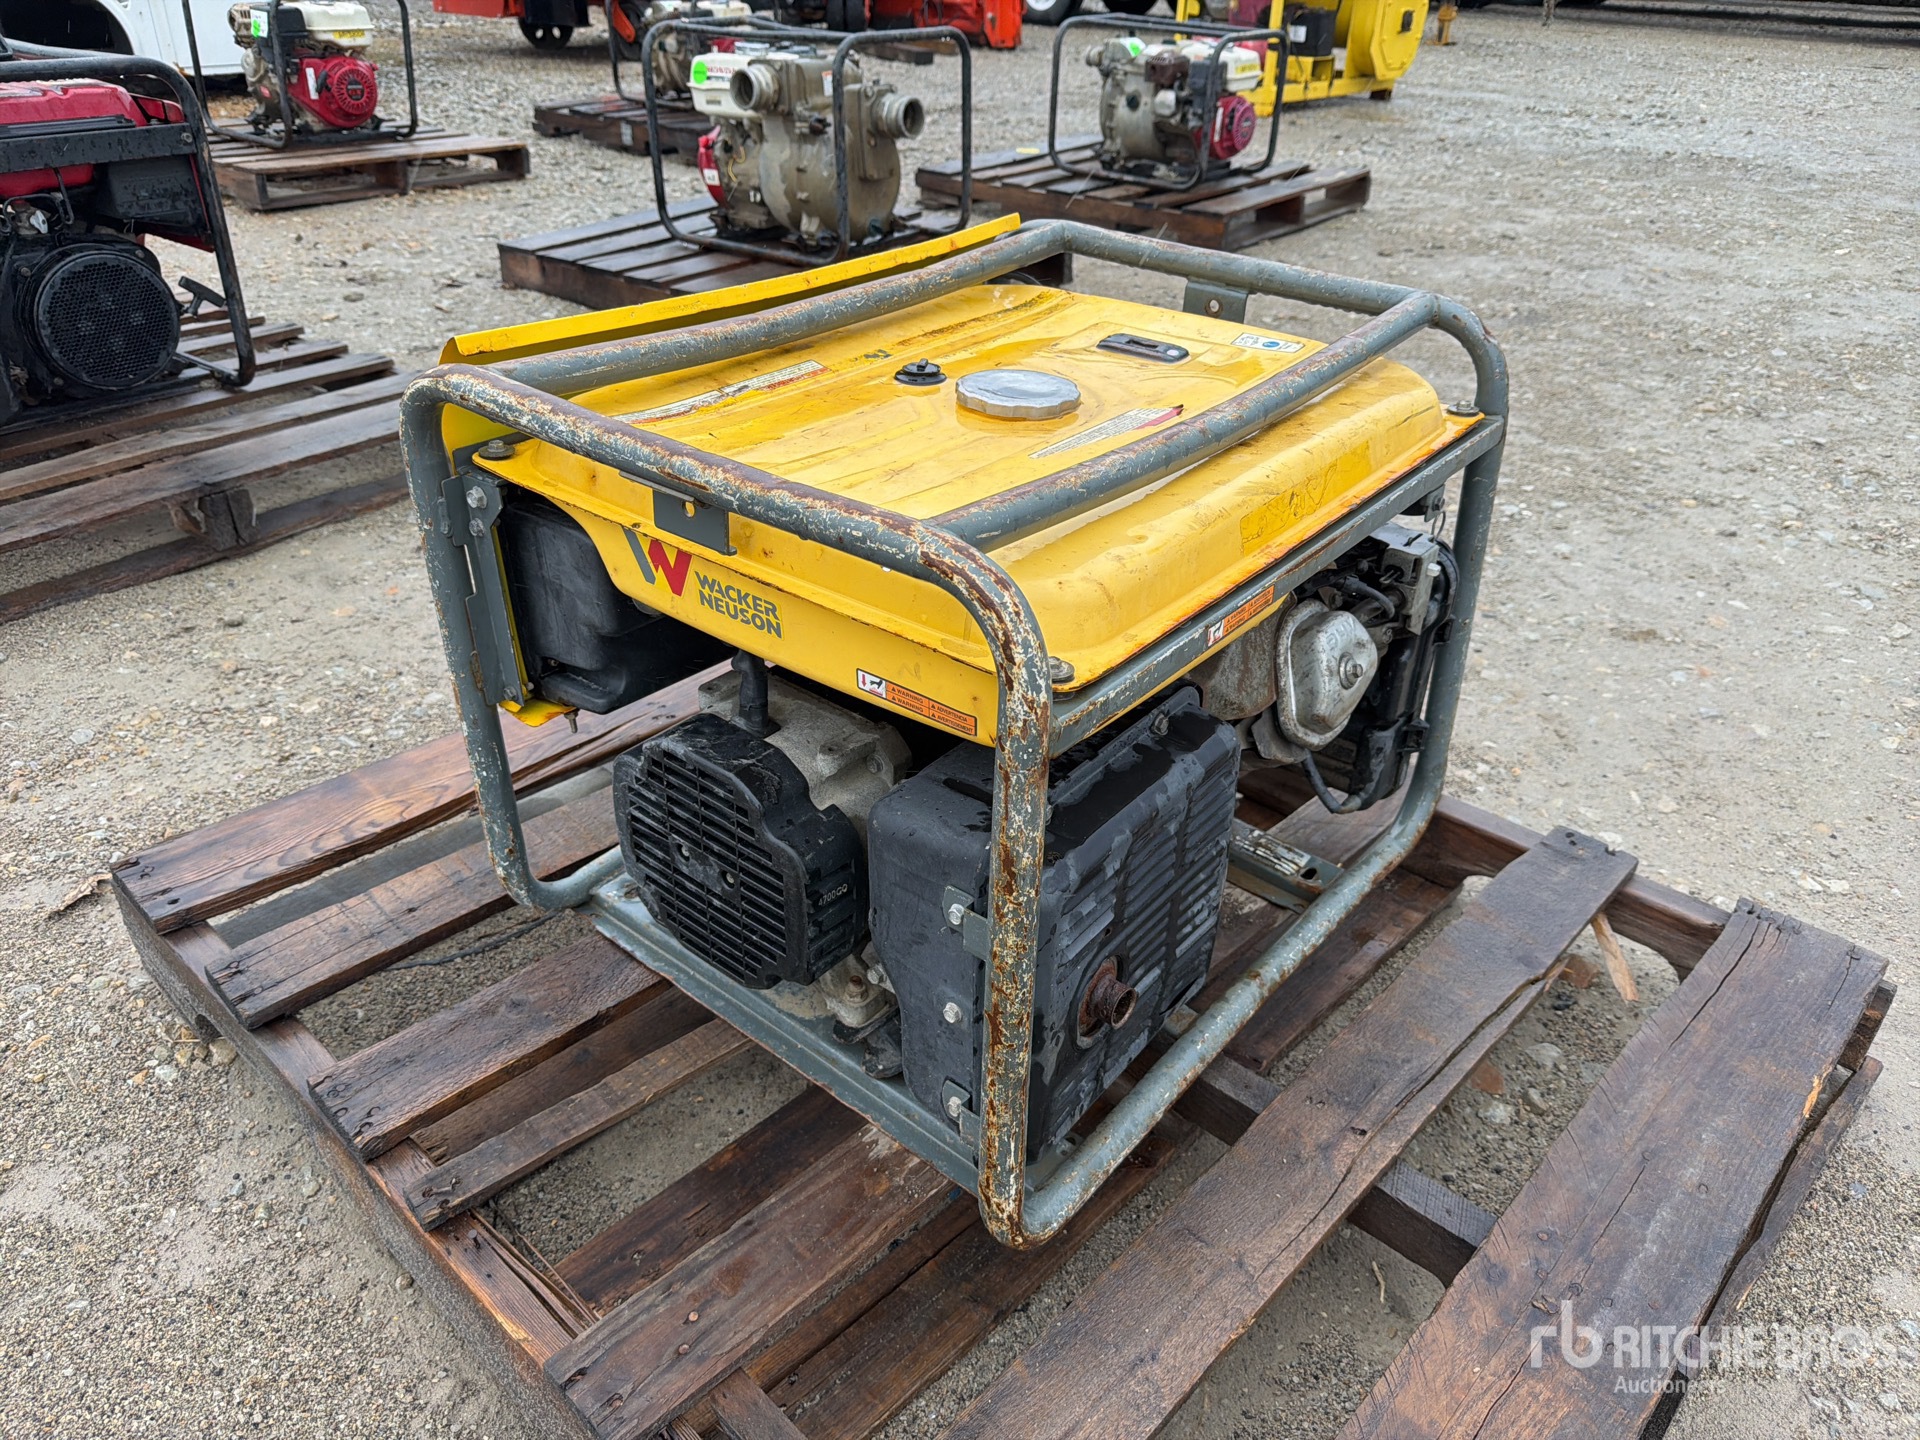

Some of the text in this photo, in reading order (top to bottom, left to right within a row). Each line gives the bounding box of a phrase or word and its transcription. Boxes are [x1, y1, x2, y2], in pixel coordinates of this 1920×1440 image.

[694, 570, 780, 620] WACKER
[698, 589, 783, 639] NEUSON
[896, 689, 924, 704] WARNING
[897, 697, 924, 713] WARNING
[936, 706, 968, 723] ADVERTENCIA
